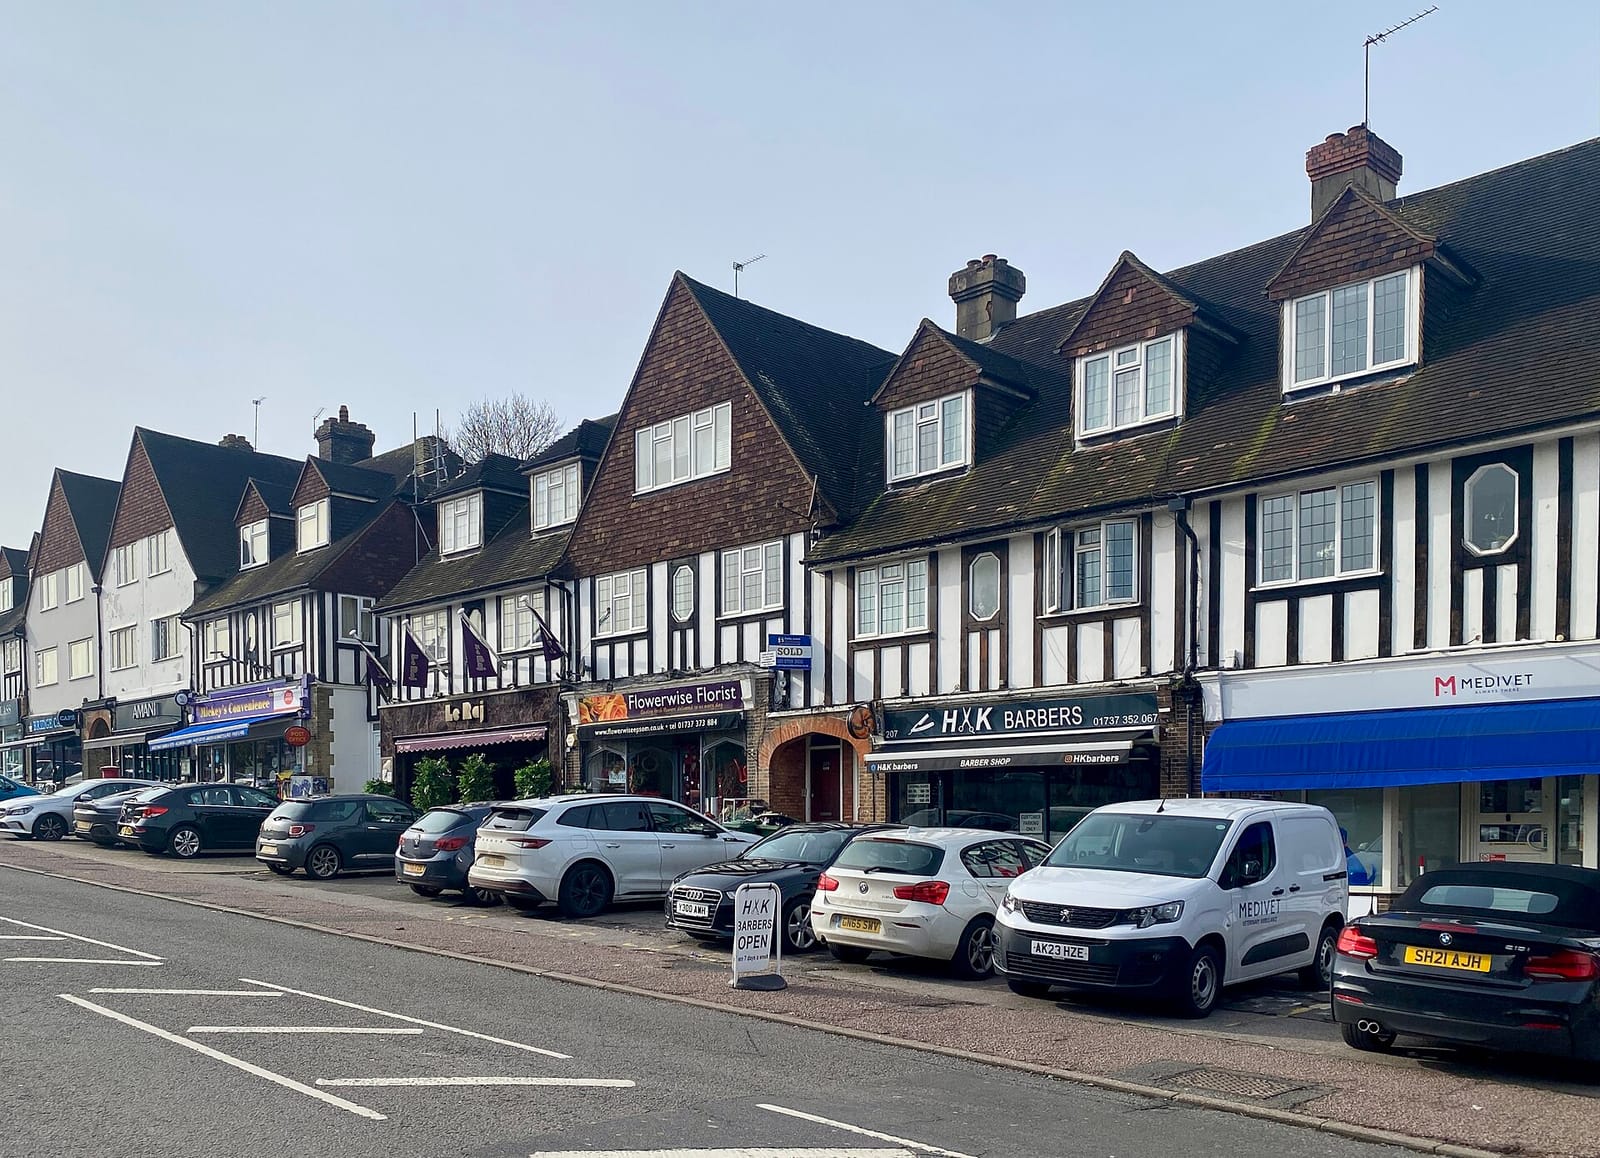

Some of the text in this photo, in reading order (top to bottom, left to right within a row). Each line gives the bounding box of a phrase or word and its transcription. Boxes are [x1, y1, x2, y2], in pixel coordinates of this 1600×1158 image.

[777, 647, 803, 656] SOLD
[1461, 673, 1533, 690] MEDIVET
[628, 686, 737, 710] Flowerwise Florist
[132, 702, 156, 719] AMANI
[228, 699, 271, 714] Convenience
[445, 700, 484, 723] Le Raj
[1004, 706, 1083, 729] BARBERS
[1093, 713, 1158, 725] 01737 352 067
[595, 725, 664, 735] www.flowerwiseepsom.co.uk
[669, 722, 677, 730] tel
[677, 720, 694, 729] 01737
[695, 719, 706, 727] 373
[885, 730, 898, 738] 207
[877, 762, 918, 771] H&K barbers
[960, 757, 1011, 767] BARBER SHOP
[1239, 899, 1280, 919] MEDIVET
[842, 917, 861, 929] GN65
[738, 935, 768, 950] OPEN
[1035, 942, 1084, 958] AK23 HZE
[1415, 949, 1482, 969] SH21 AJH
